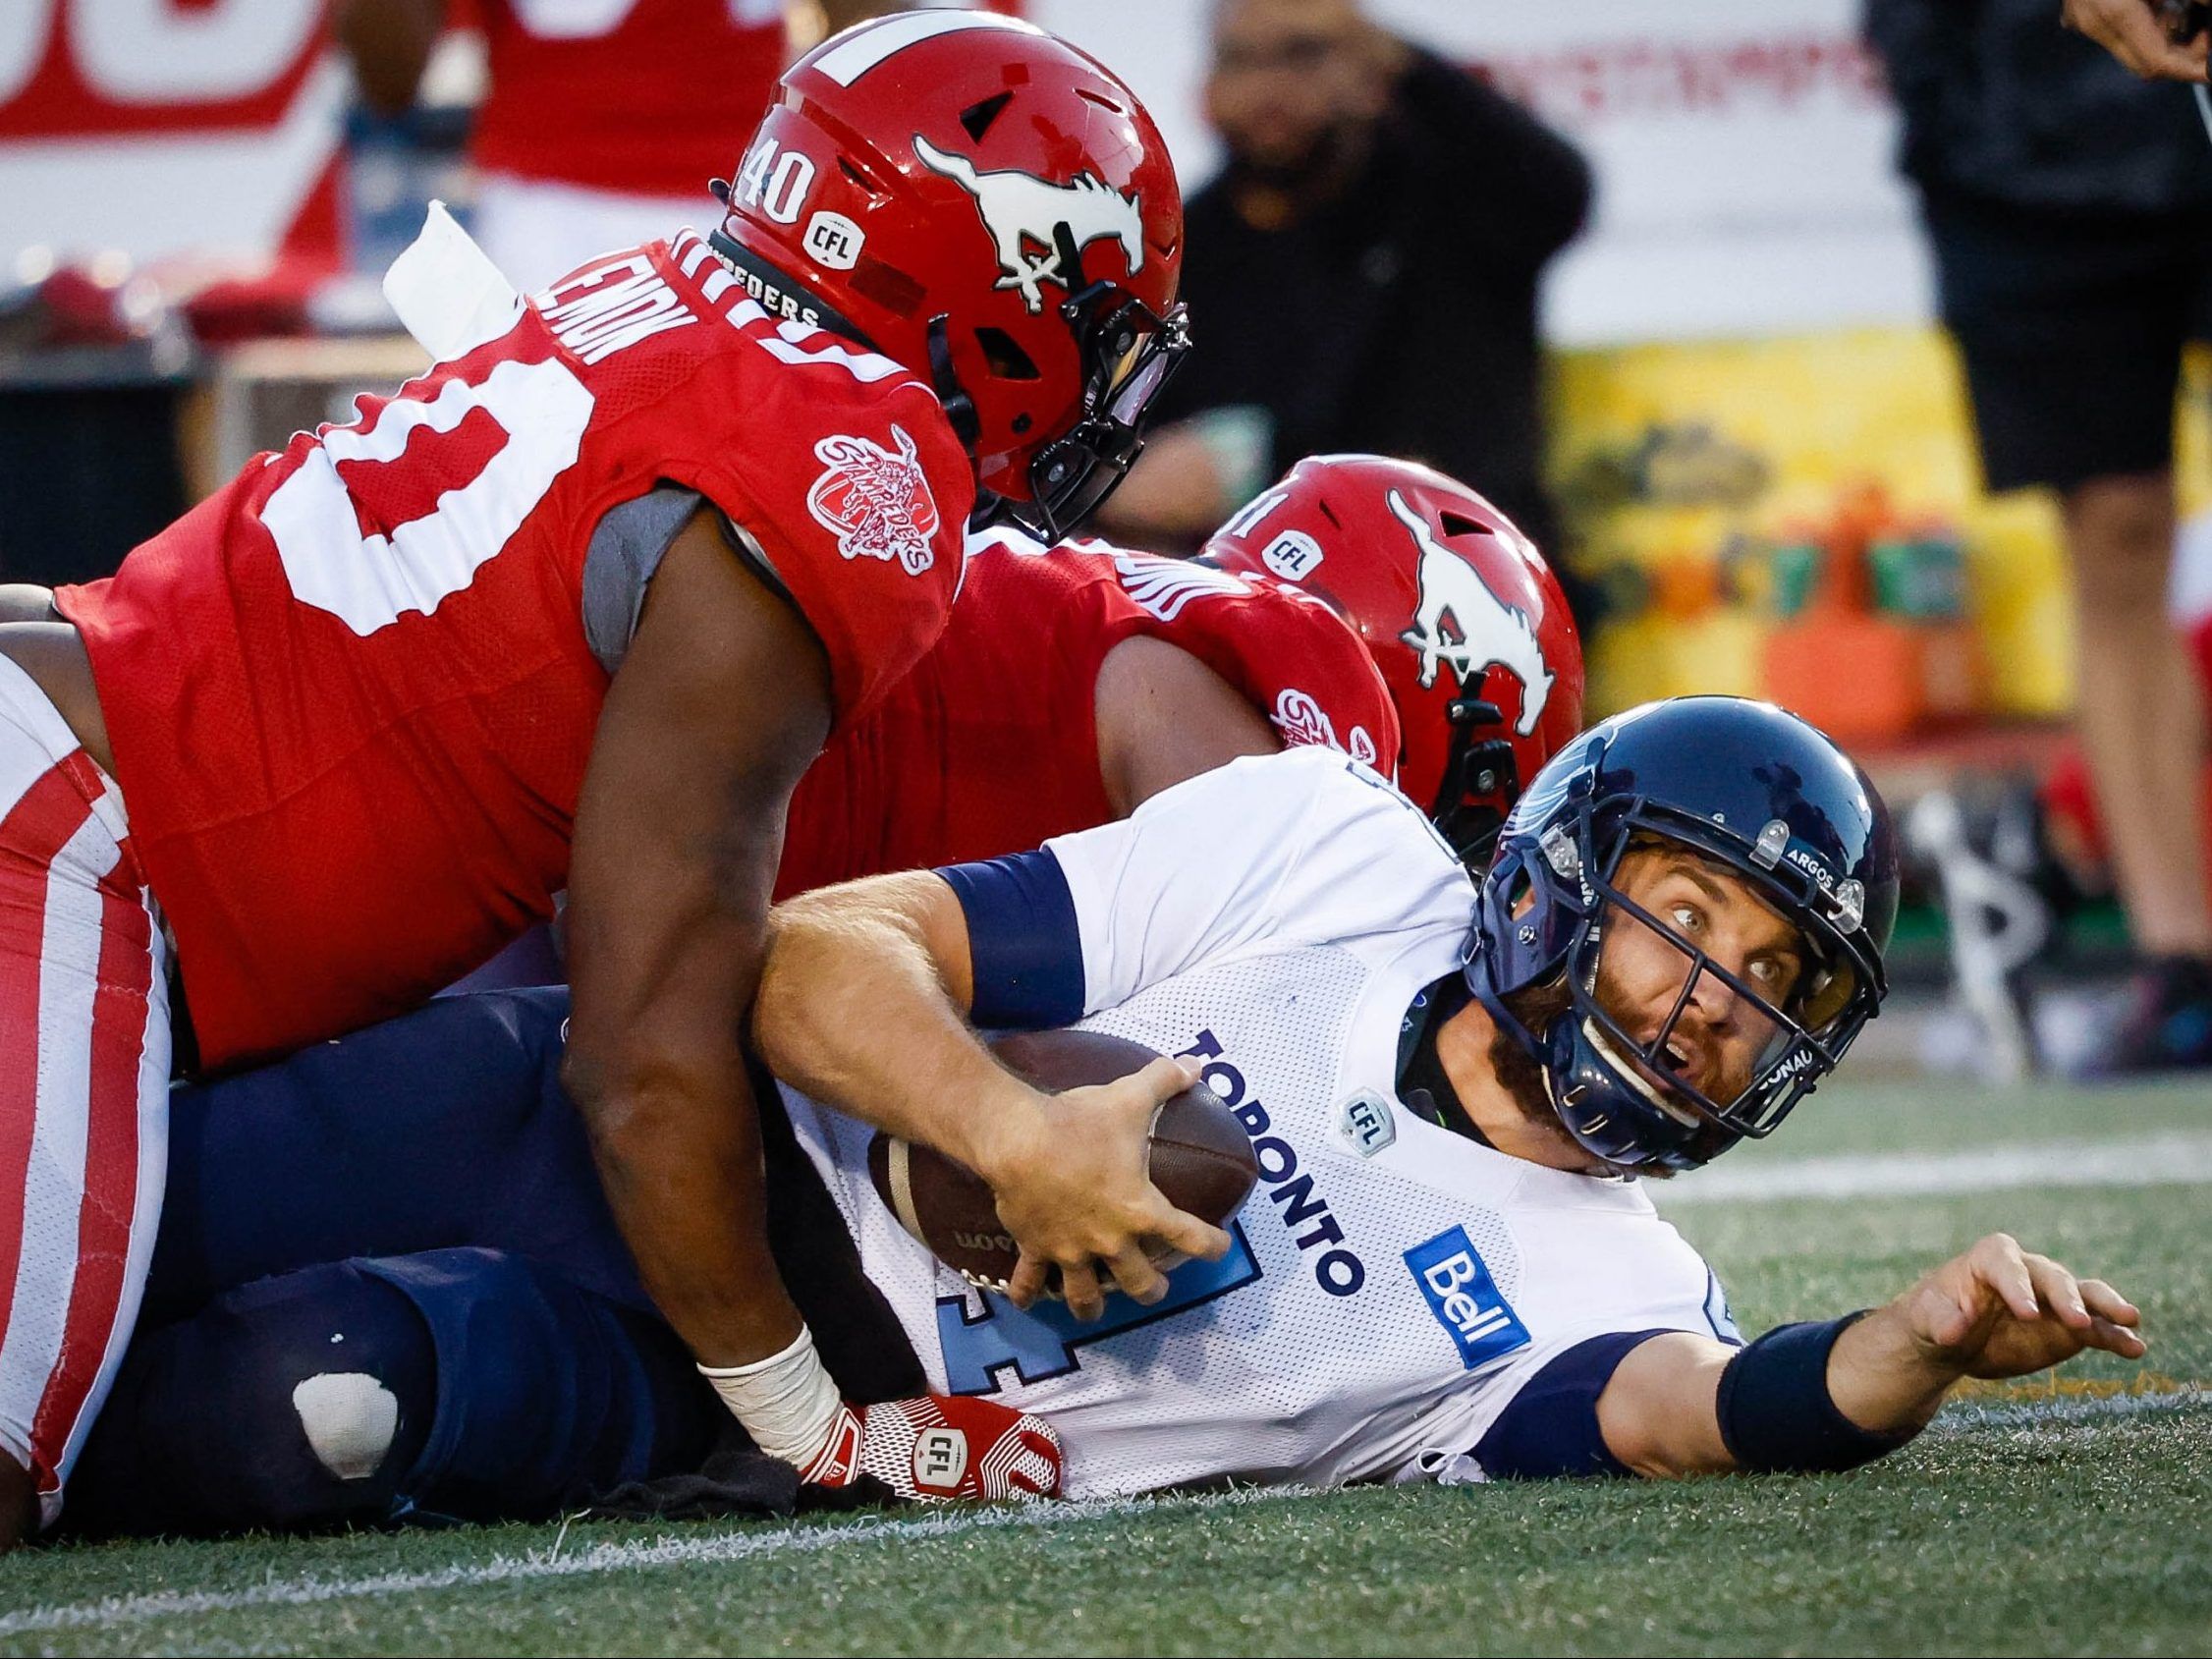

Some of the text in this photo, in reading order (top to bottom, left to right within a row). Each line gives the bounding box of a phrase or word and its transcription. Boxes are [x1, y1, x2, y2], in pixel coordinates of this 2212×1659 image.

[734, 137, 816, 225] 40
[812, 224, 849, 260] CFL
[1272, 539, 1308, 573] CFL
[1787, 849, 1835, 890] ARGOS
[1348, 1100, 1382, 1146] CFL
[1173, 1027, 1366, 1298] TORONTO
[1422, 1248, 1513, 1346] Bell
[926, 1435, 953, 1477] CFL
